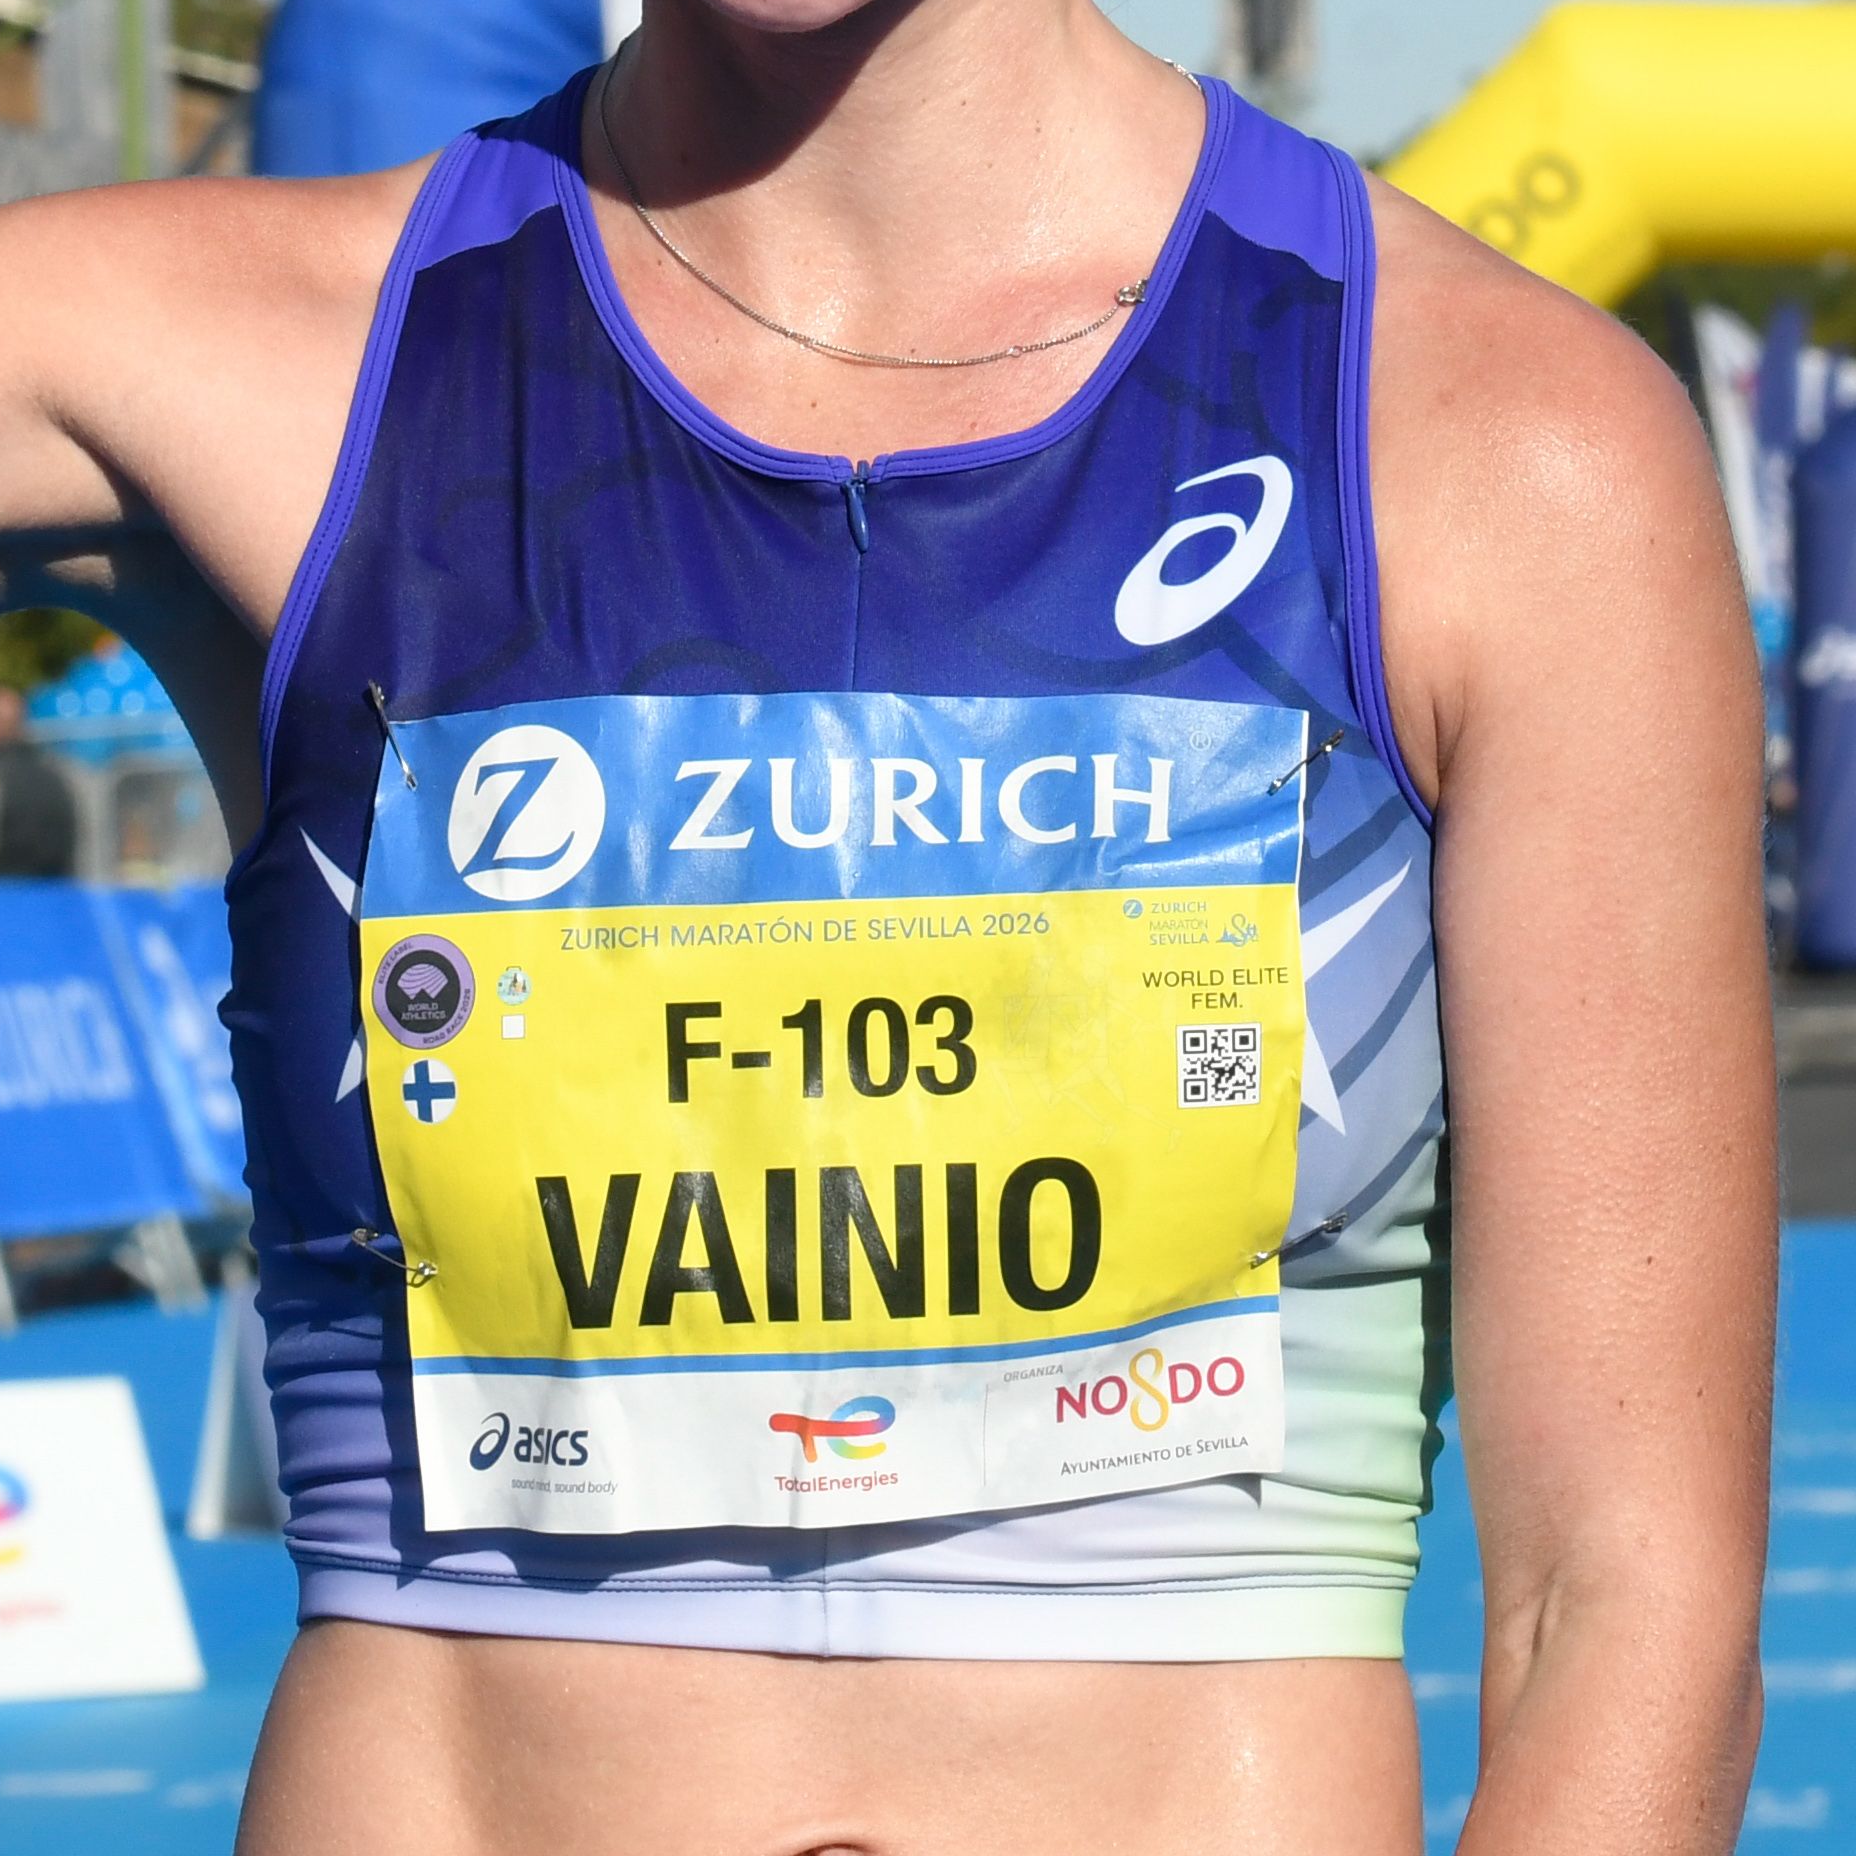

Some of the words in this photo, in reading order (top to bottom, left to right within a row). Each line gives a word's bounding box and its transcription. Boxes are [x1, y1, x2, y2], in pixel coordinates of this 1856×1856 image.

[668, 752, 1176, 851] ZURICH
[1151, 901, 1207, 914] ZURICH
[560, 925, 659, 951] ZURICH
[671, 915, 814, 947] MARATÓN
[823, 919, 858, 943] DE
[868, 914, 972, 941] SEVILLA
[982, 912, 1051, 937] 2026
[1149, 932, 1210, 946] SEVILLA
[1142, 969, 1225, 989] WORLD
[1232, 967, 1289, 986] ELITE
[407, 1002, 439, 1012] WORLD
[1191, 992, 1244, 1010] FEM.
[400, 1010, 447, 1021] ATHLETICS
[665, 994, 978, 1104] F-103
[534, 1156, 1102, 1330] VAINIO
[1003, 1363, 1064, 1383] ORGANIZA
[513, 1426, 589, 1466] asics
[553, 1480, 585, 1494] sound
[588, 1479, 618, 1496] body
[773, 1470, 900, 1494] TotalEnergies
